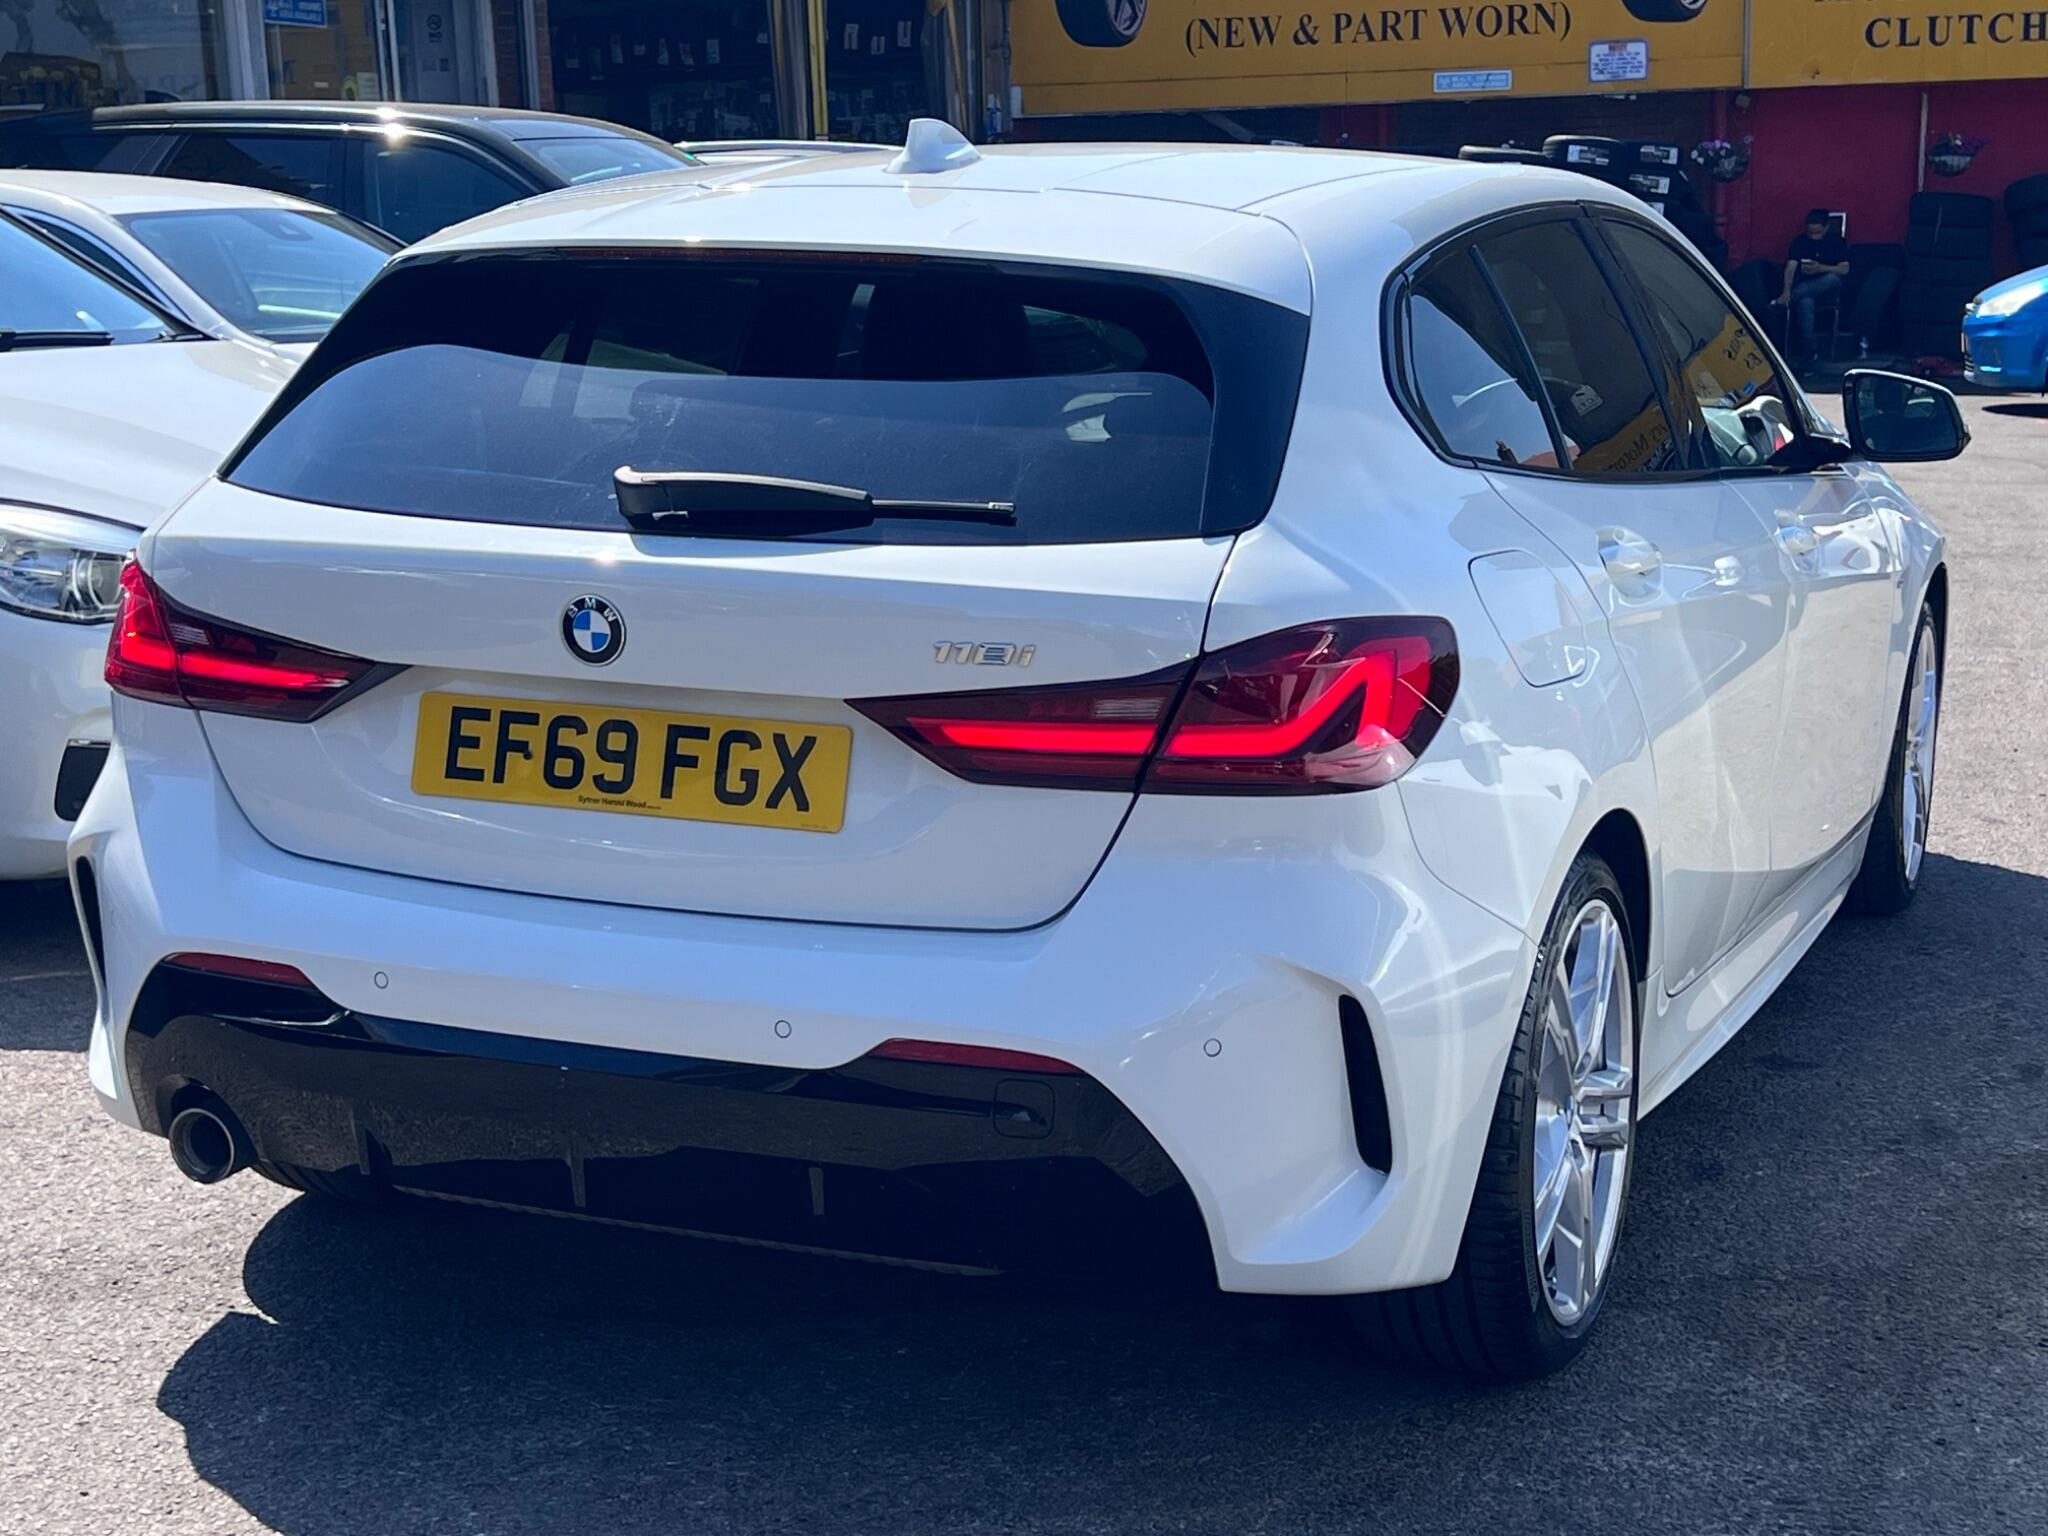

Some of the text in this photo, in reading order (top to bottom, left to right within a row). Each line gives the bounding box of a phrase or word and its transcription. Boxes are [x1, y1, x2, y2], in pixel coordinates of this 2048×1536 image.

[1184, 1, 1572, 57] (NEW & PART WORN)
[1863, 10, 2048, 49] CLUTCH
[567, 596, 618, 622] BMW
[932, 640, 1036, 667] 118i
[443, 705, 818, 813] EF69 FGX
[626, 799, 647, 809] Wood
